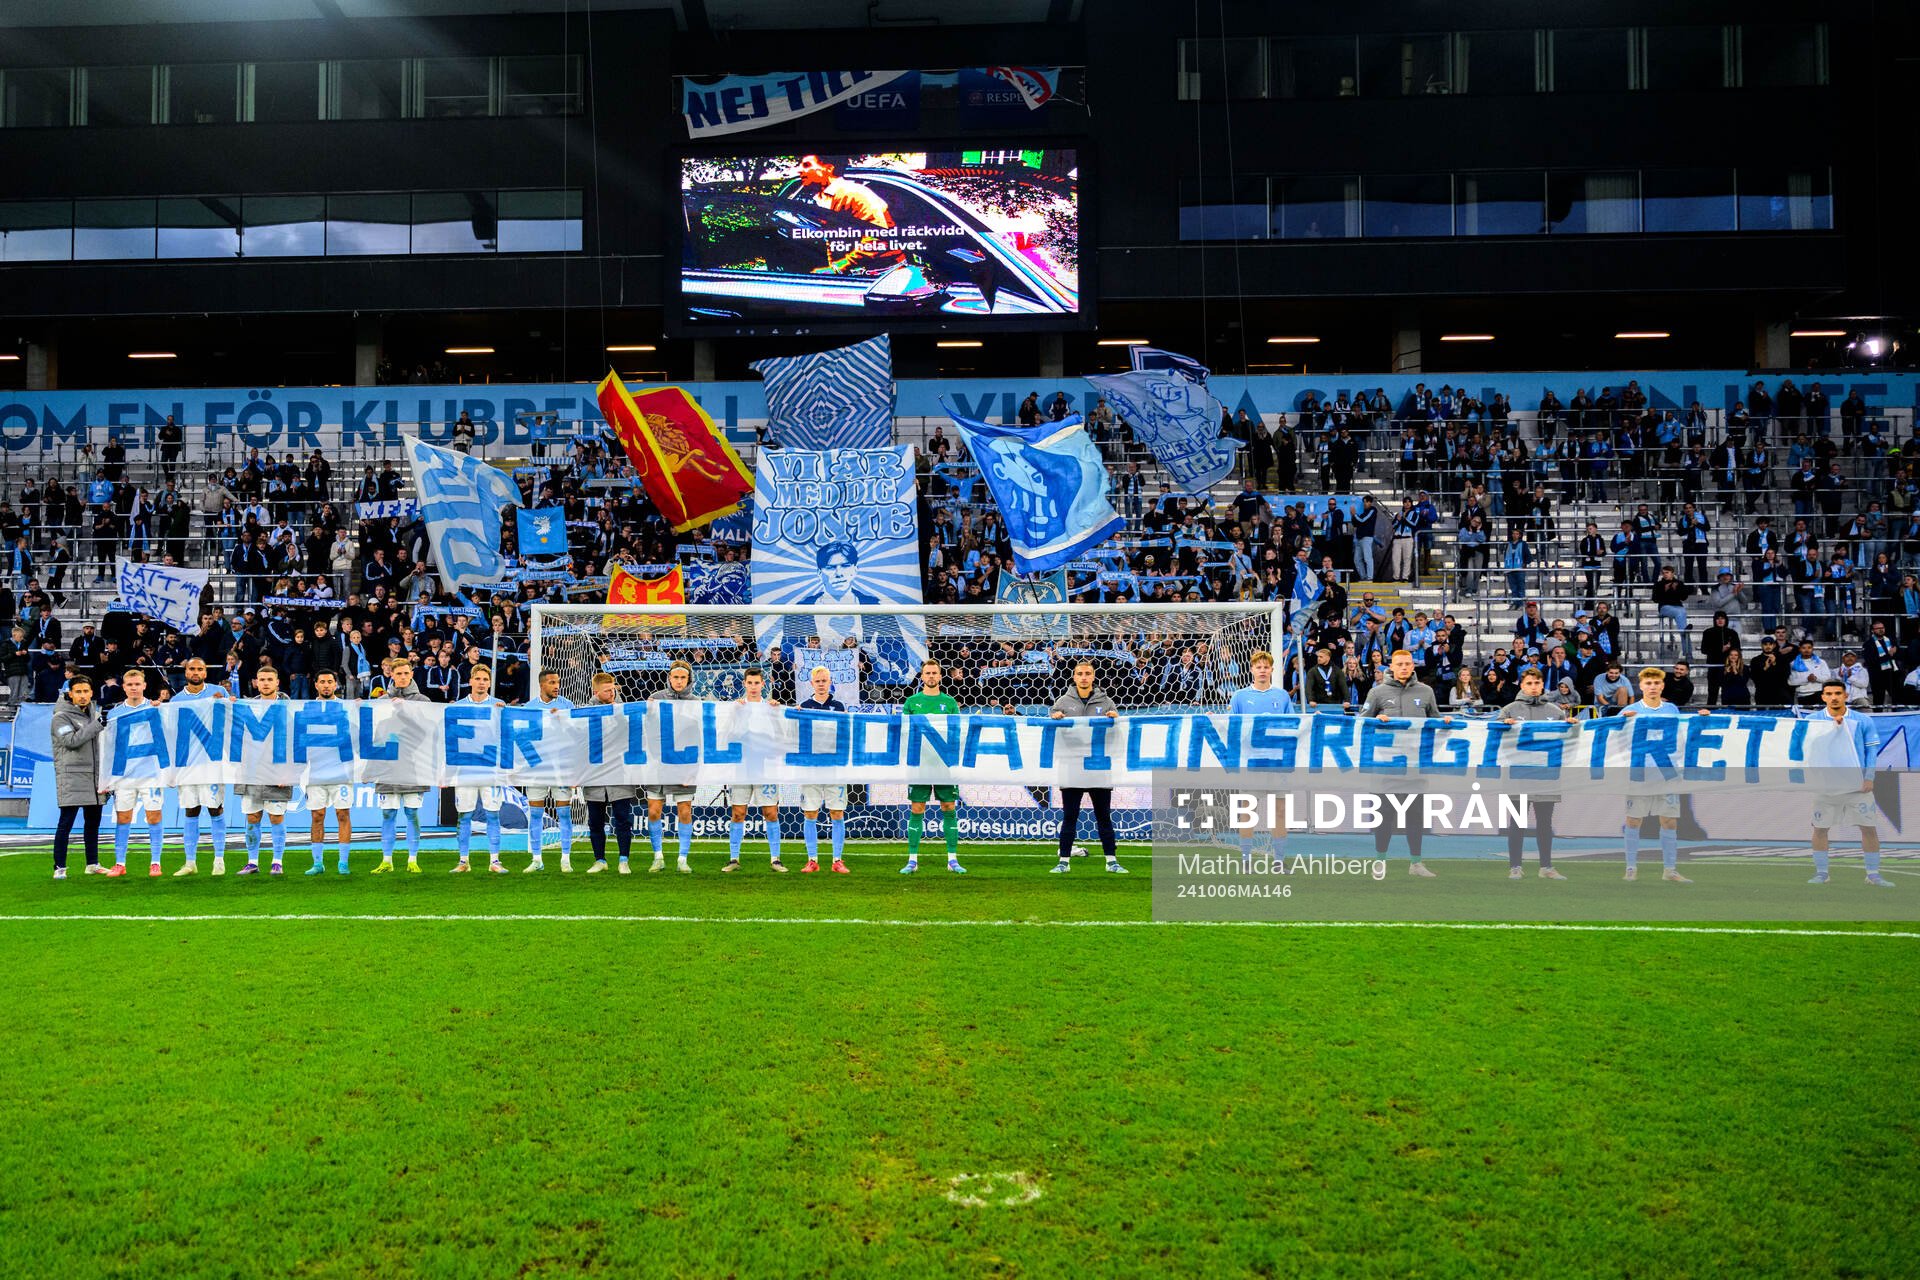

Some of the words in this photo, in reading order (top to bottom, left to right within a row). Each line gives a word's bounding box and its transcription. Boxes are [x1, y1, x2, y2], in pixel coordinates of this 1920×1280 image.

[687, 84, 770, 129] NEJ
[847, 92, 907, 114] UEFA
[792, 227, 862, 240] Elkombin
[864, 225, 899, 238] med
[901, 224, 966, 237] räckvidd
[830, 239, 852, 252] för
[854, 239, 887, 251] hela
[889, 239, 927, 251] livet.
[205, 389, 323, 448] FÖR
[767, 453, 819, 483] VI
[831, 450, 905, 482] ÄR
[774, 479, 842, 511] MED
[844, 478, 897, 507] DIG
[754, 504, 916, 546] JONTE
[112, 698, 399, 777] ANMÄL
[445, 705, 544, 770] ER
[571, 701, 742, 767] TILL
[785, 707, 1810, 785] DONATIONSREGISTRET!
[210, 784, 219, 797] 9
[340, 786, 349, 798] 8
[762, 784, 778, 796] 23
[838, 786, 845, 798] 7
[742, 815, 767, 836] pri
